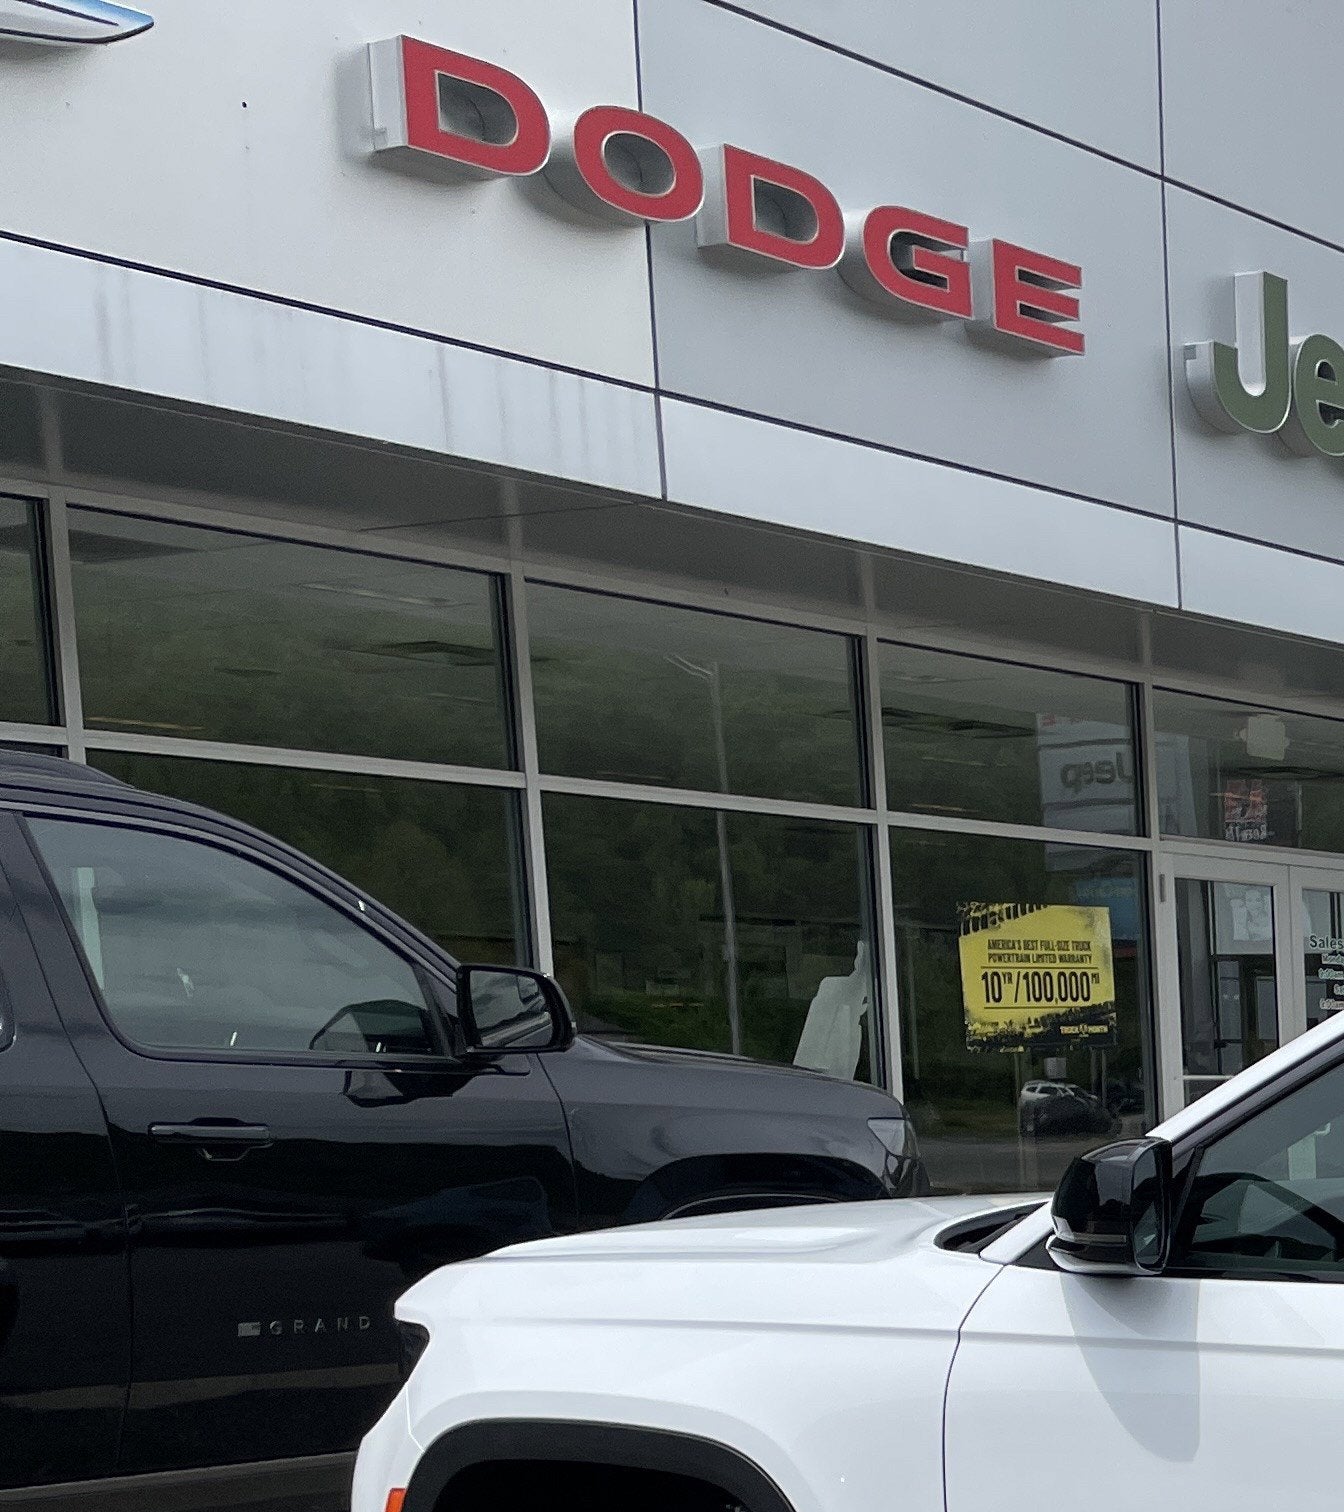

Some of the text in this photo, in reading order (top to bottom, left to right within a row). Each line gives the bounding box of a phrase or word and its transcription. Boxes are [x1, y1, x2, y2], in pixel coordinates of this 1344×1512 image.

[398, 34, 1086, 356] DODGE
[987, 939, 1092, 951] AMERICA'S BEST FULL-SIZE TRUCK
[1309, 935, 1344, 950] Sales
[988, 953, 1092, 964] POWERTRAIN LIMITED WARRANTY
[269, 1315, 373, 1336] GRAND
